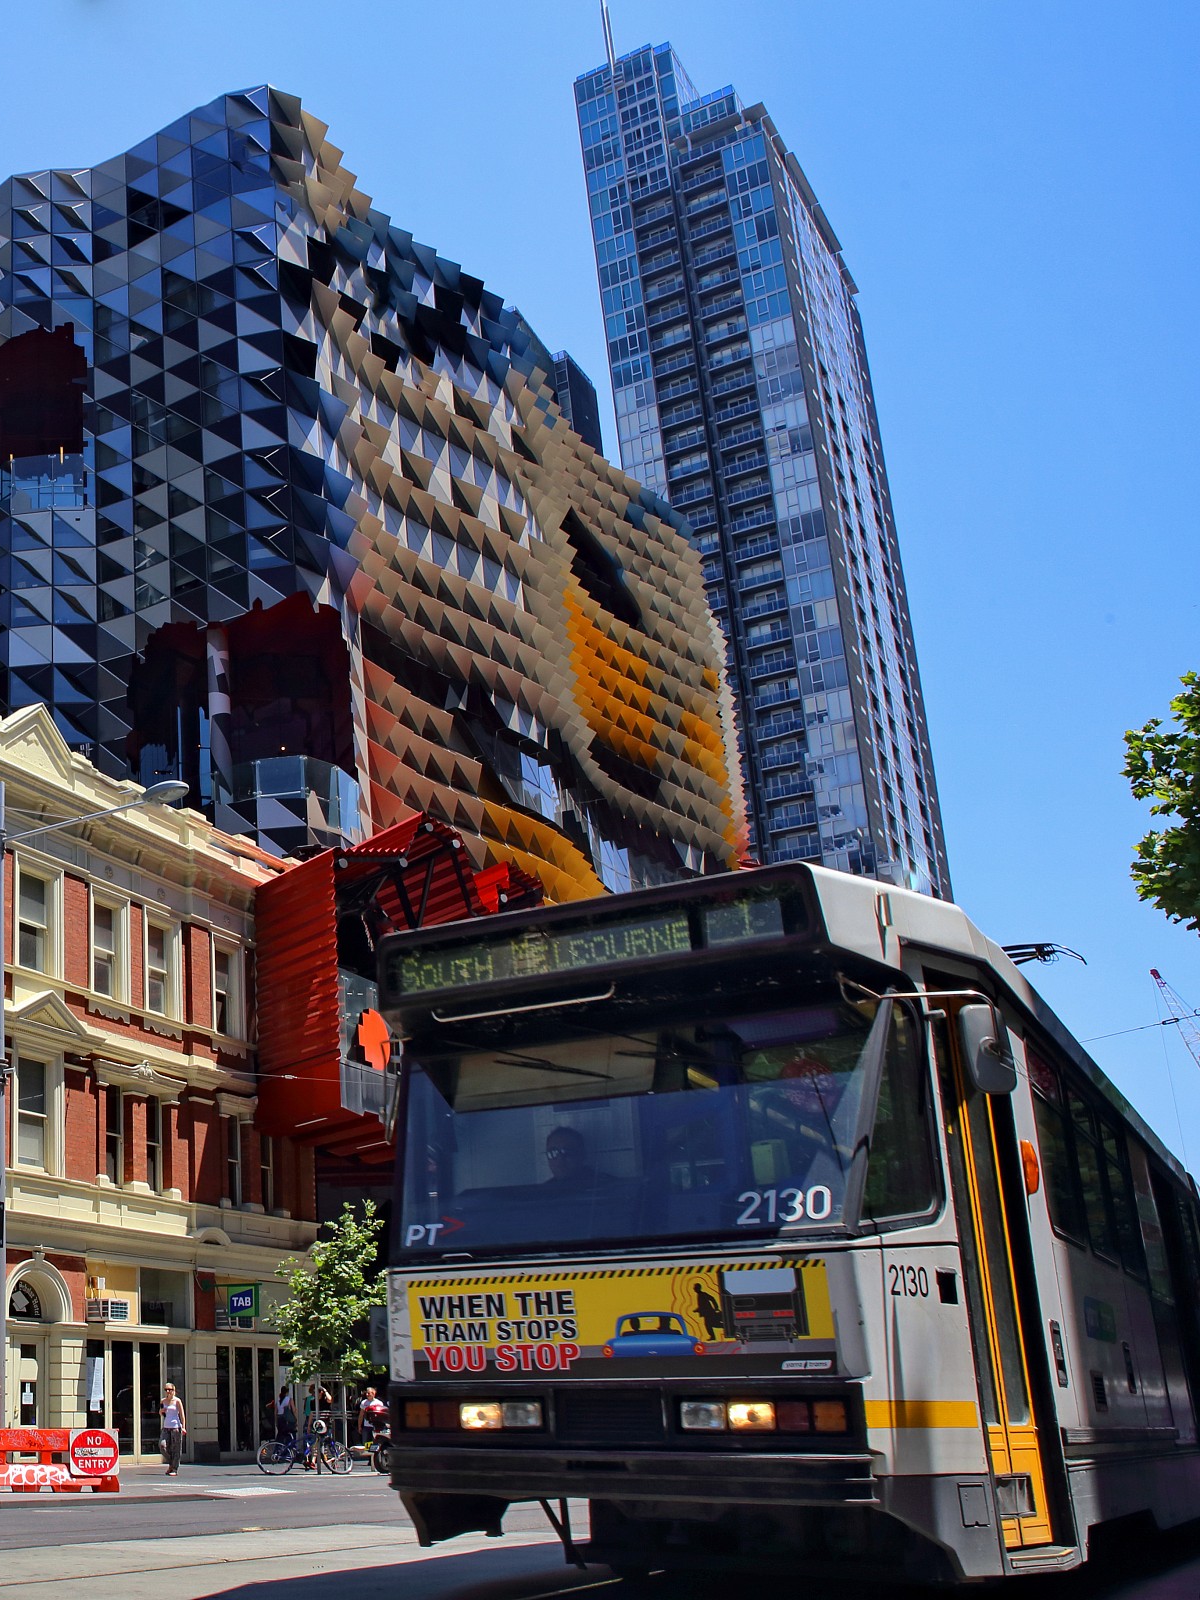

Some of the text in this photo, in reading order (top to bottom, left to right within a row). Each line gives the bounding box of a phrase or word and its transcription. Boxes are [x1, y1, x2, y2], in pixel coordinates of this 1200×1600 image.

[402, 918, 691, 993] SOUTH MELBOURNE
[736, 1184, 832, 1226] 2130
[404, 1223, 445, 1247] PT
[888, 1264, 929, 1298] 2130
[231, 1296, 252, 1307] TAB
[419, 1289, 576, 1320] WHEN THE
[420, 1318, 578, 1343] TRAM STOPS
[423, 1342, 580, 1372] YOU STOP
[87, 1437, 102, 1445] NO
[78, 1459, 112, 1469] ENTRY
